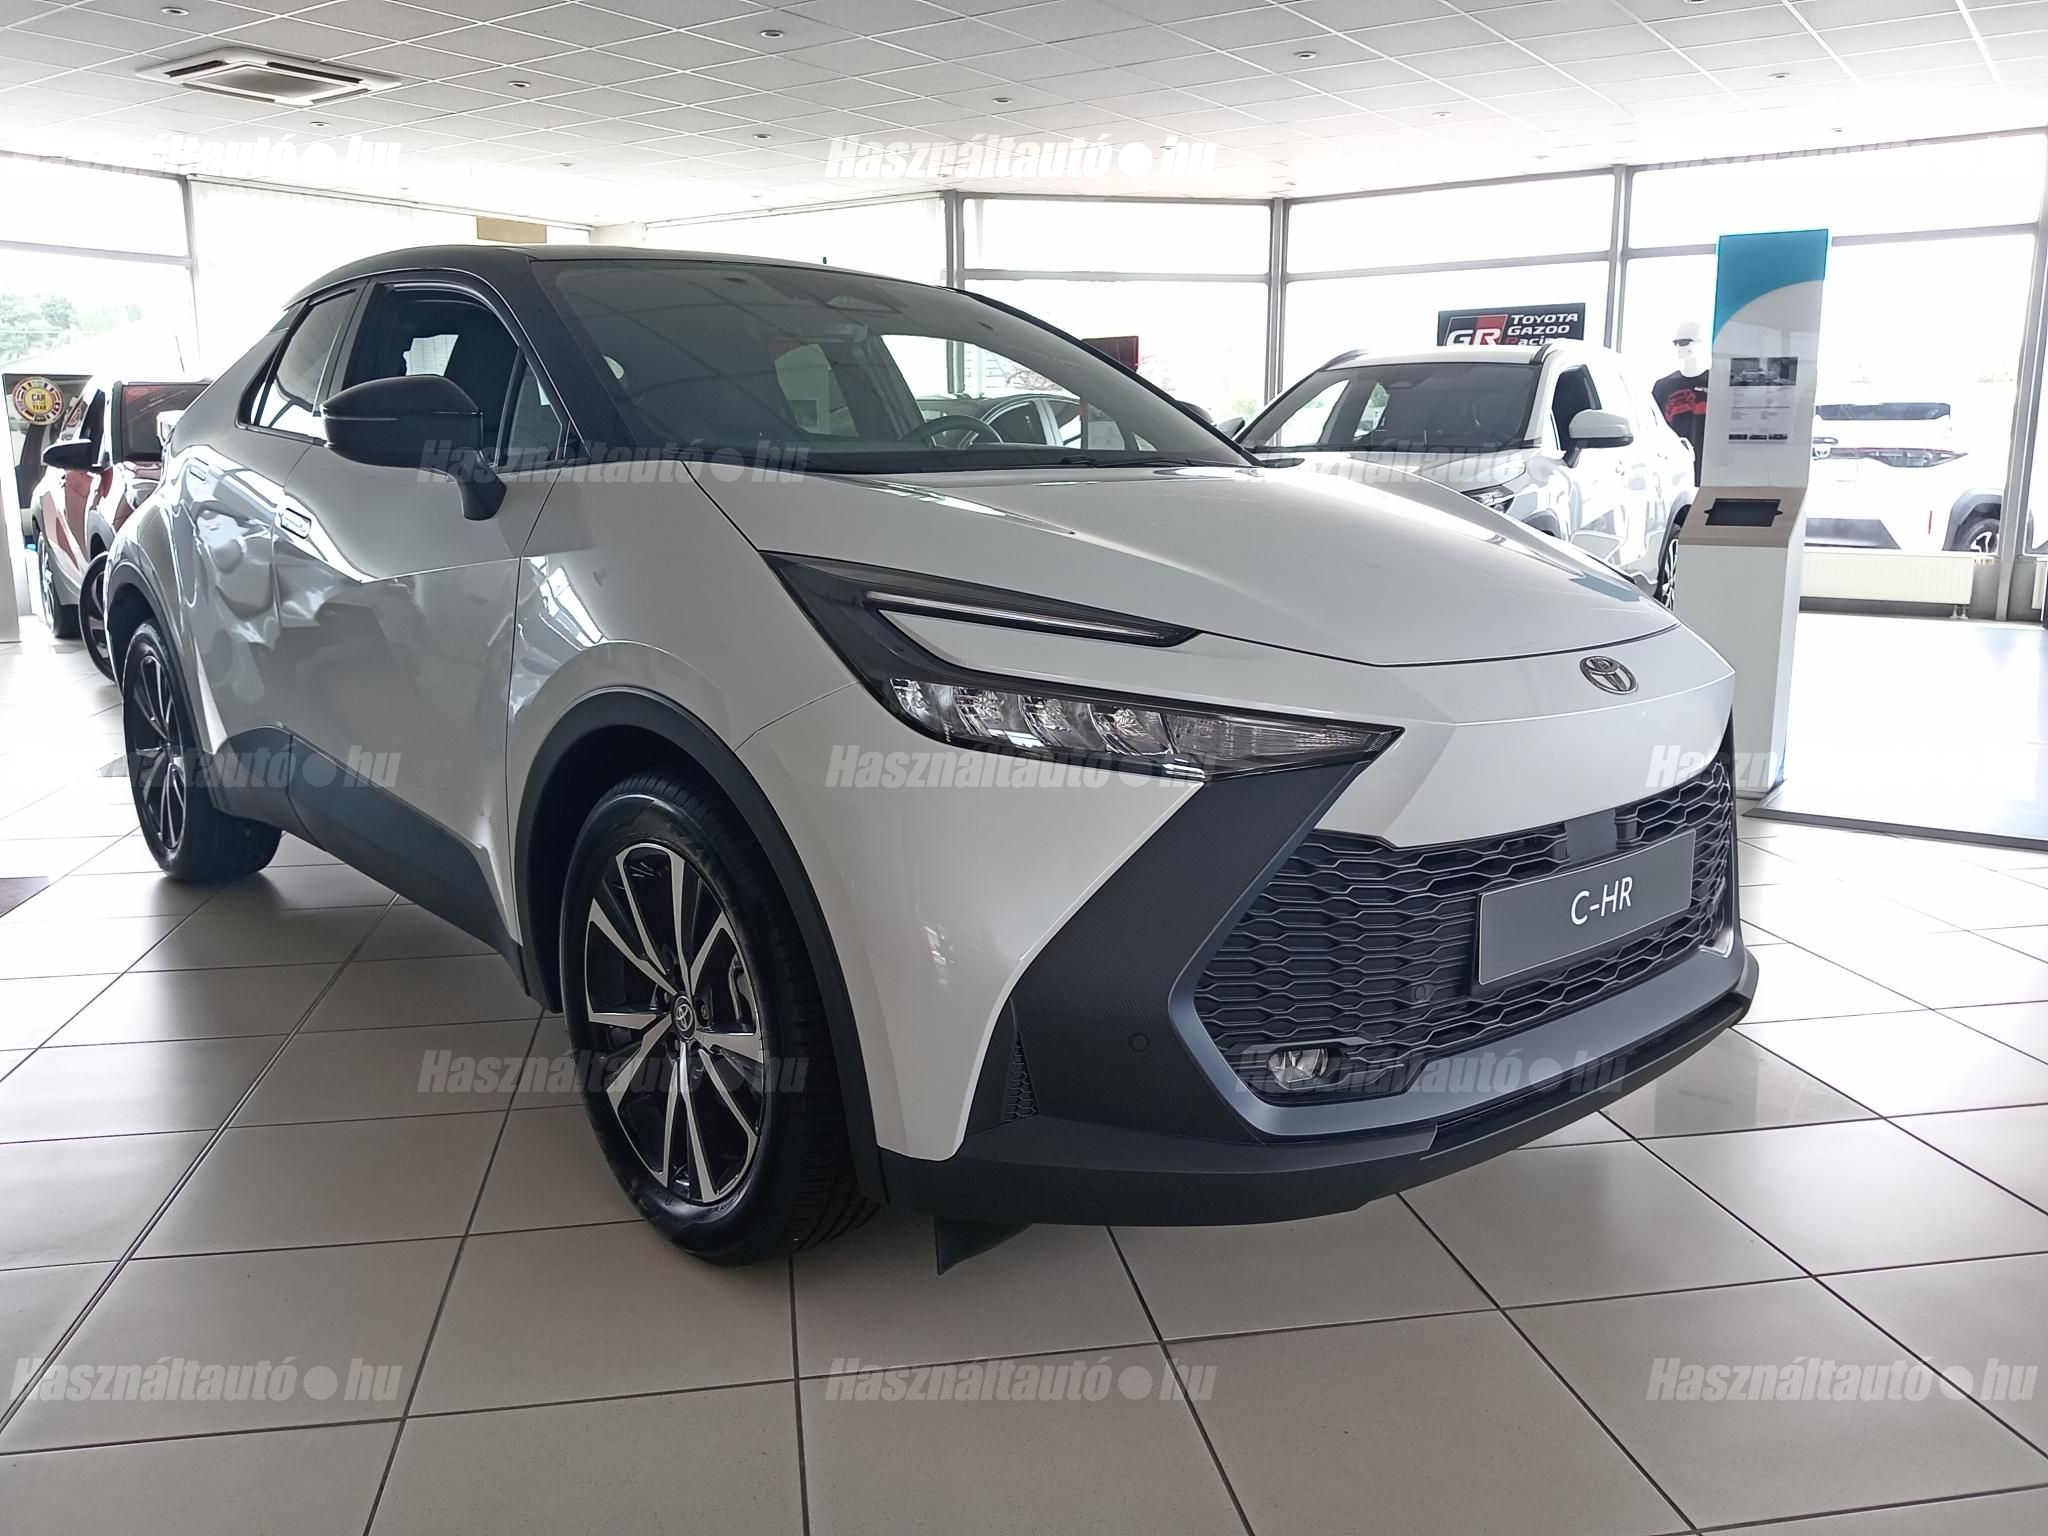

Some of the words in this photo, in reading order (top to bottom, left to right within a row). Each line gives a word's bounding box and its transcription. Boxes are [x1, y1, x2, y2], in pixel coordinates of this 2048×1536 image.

[1511, 313, 1578, 325] TOYOTA
[1507, 325, 1570, 336] GAZOO
[1446, 328, 1501, 346] GR
[1505, 336, 1553, 346] Raci
[31, 393, 47, 402] CAR
[1570, 875, 1634, 926] C-HR
